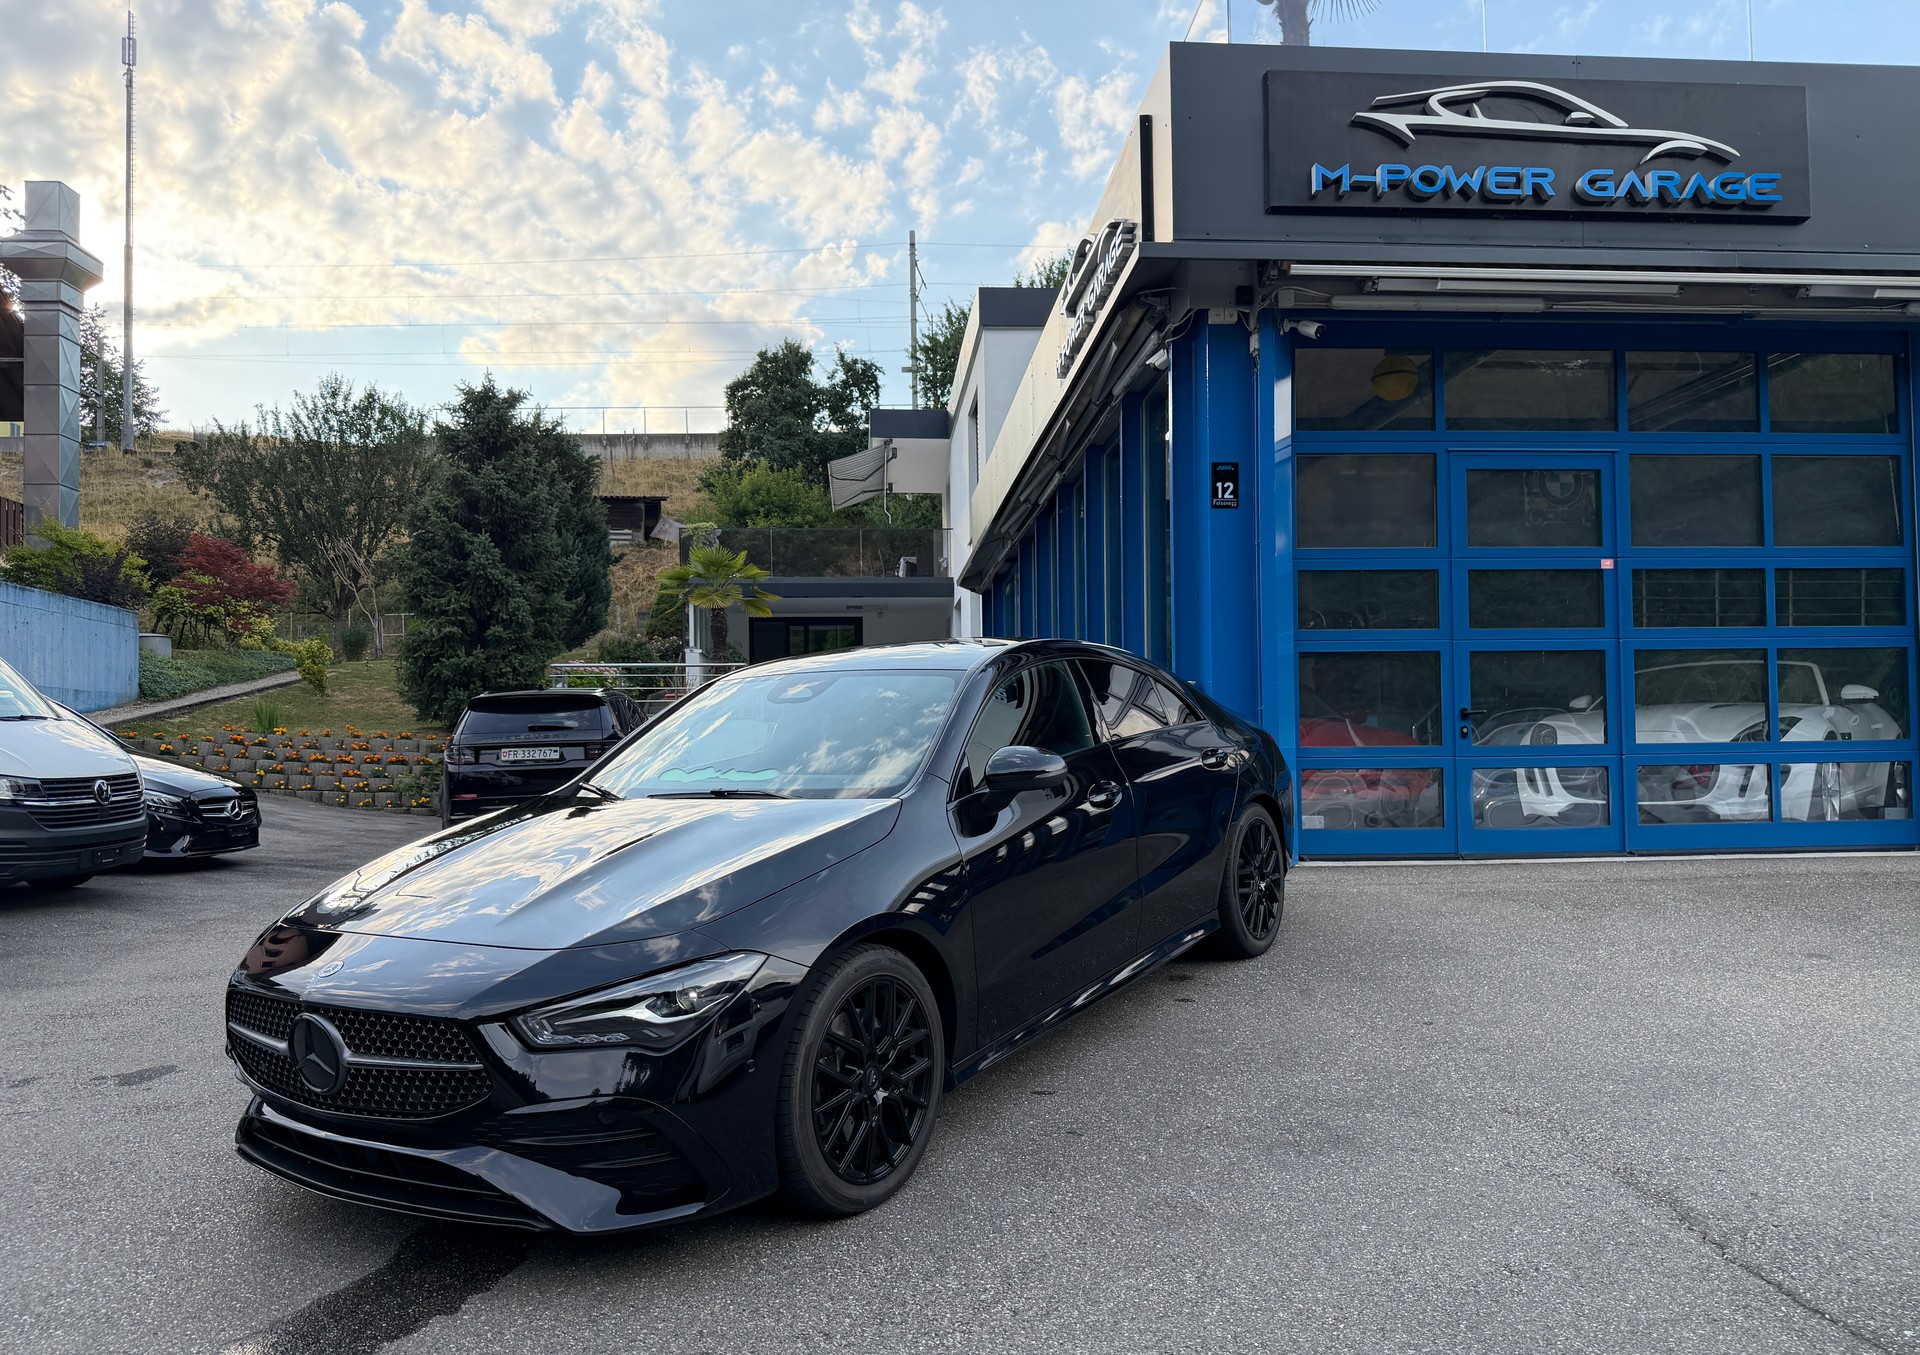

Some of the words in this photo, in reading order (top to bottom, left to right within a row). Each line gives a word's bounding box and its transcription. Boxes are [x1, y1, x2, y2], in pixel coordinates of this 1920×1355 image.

[1313, 162, 1556, 199] M-POWER
[1577, 168, 1783, 203] GARAGE
[1087, 222, 1124, 312] GARAGE
[1216, 481, 1234, 499] 12
